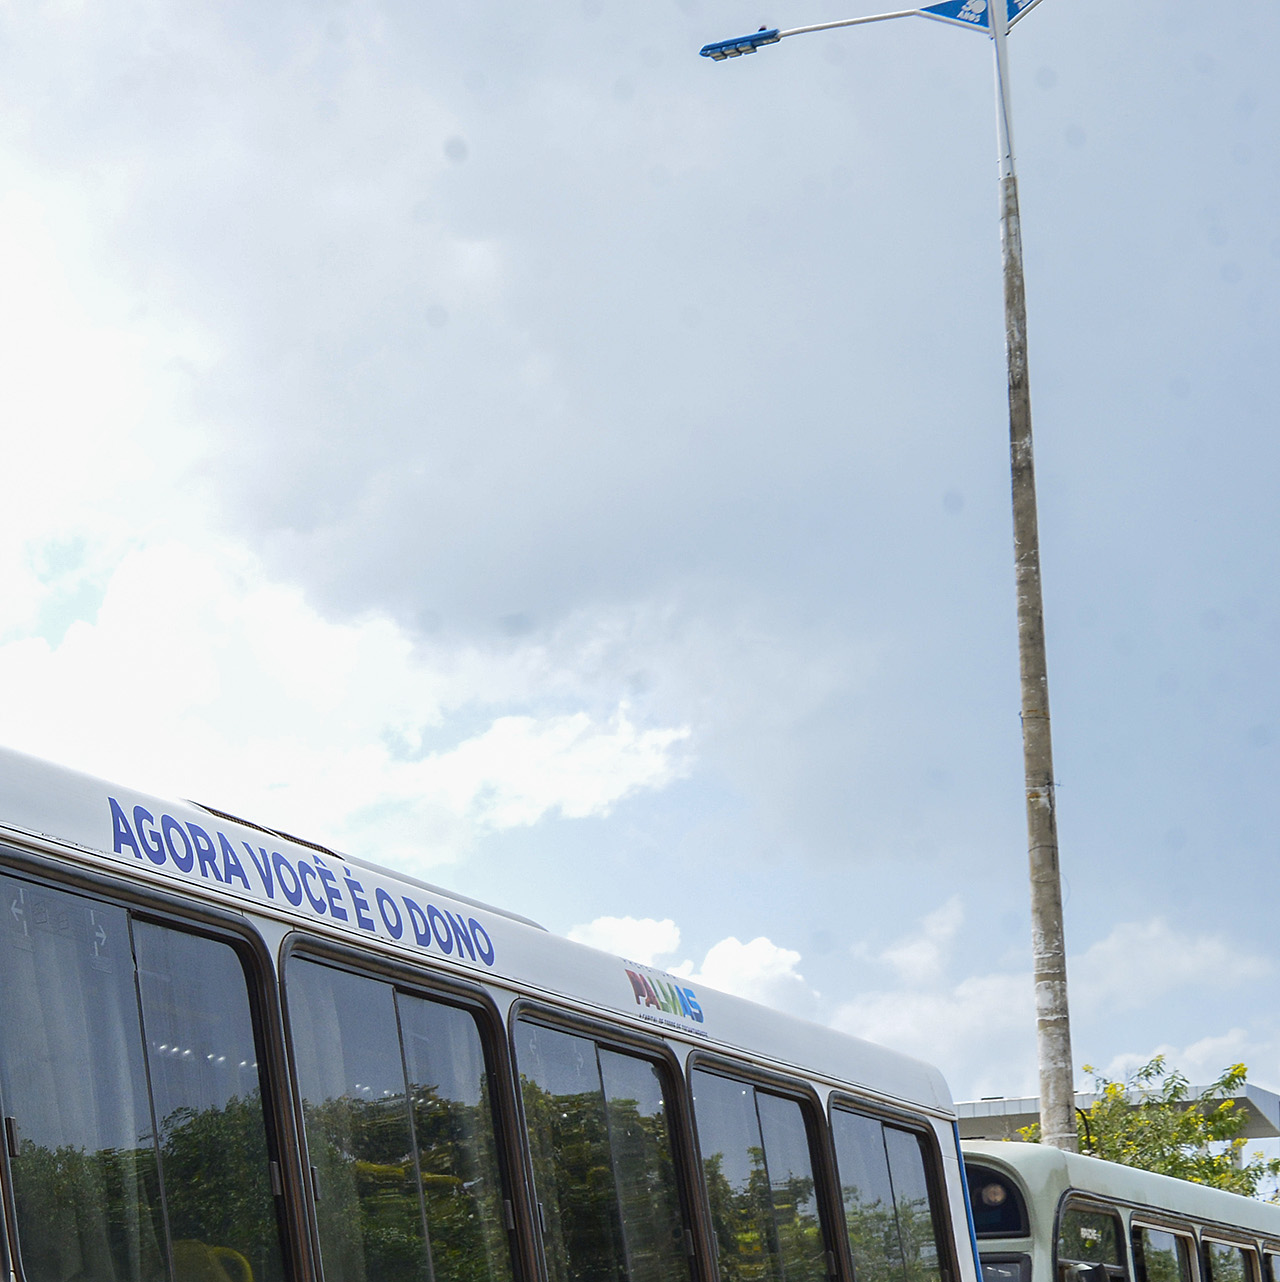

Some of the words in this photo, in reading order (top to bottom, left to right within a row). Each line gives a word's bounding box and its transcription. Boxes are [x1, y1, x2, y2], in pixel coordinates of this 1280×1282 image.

[107, 796, 252, 891] AGORA
[241, 840, 349, 923] VOCÊ
[343, 866, 376, 933] É
[375, 886, 403, 941] O
[401, 896, 496, 968] DONO
[624, 968, 704, 1024] PALMAS
